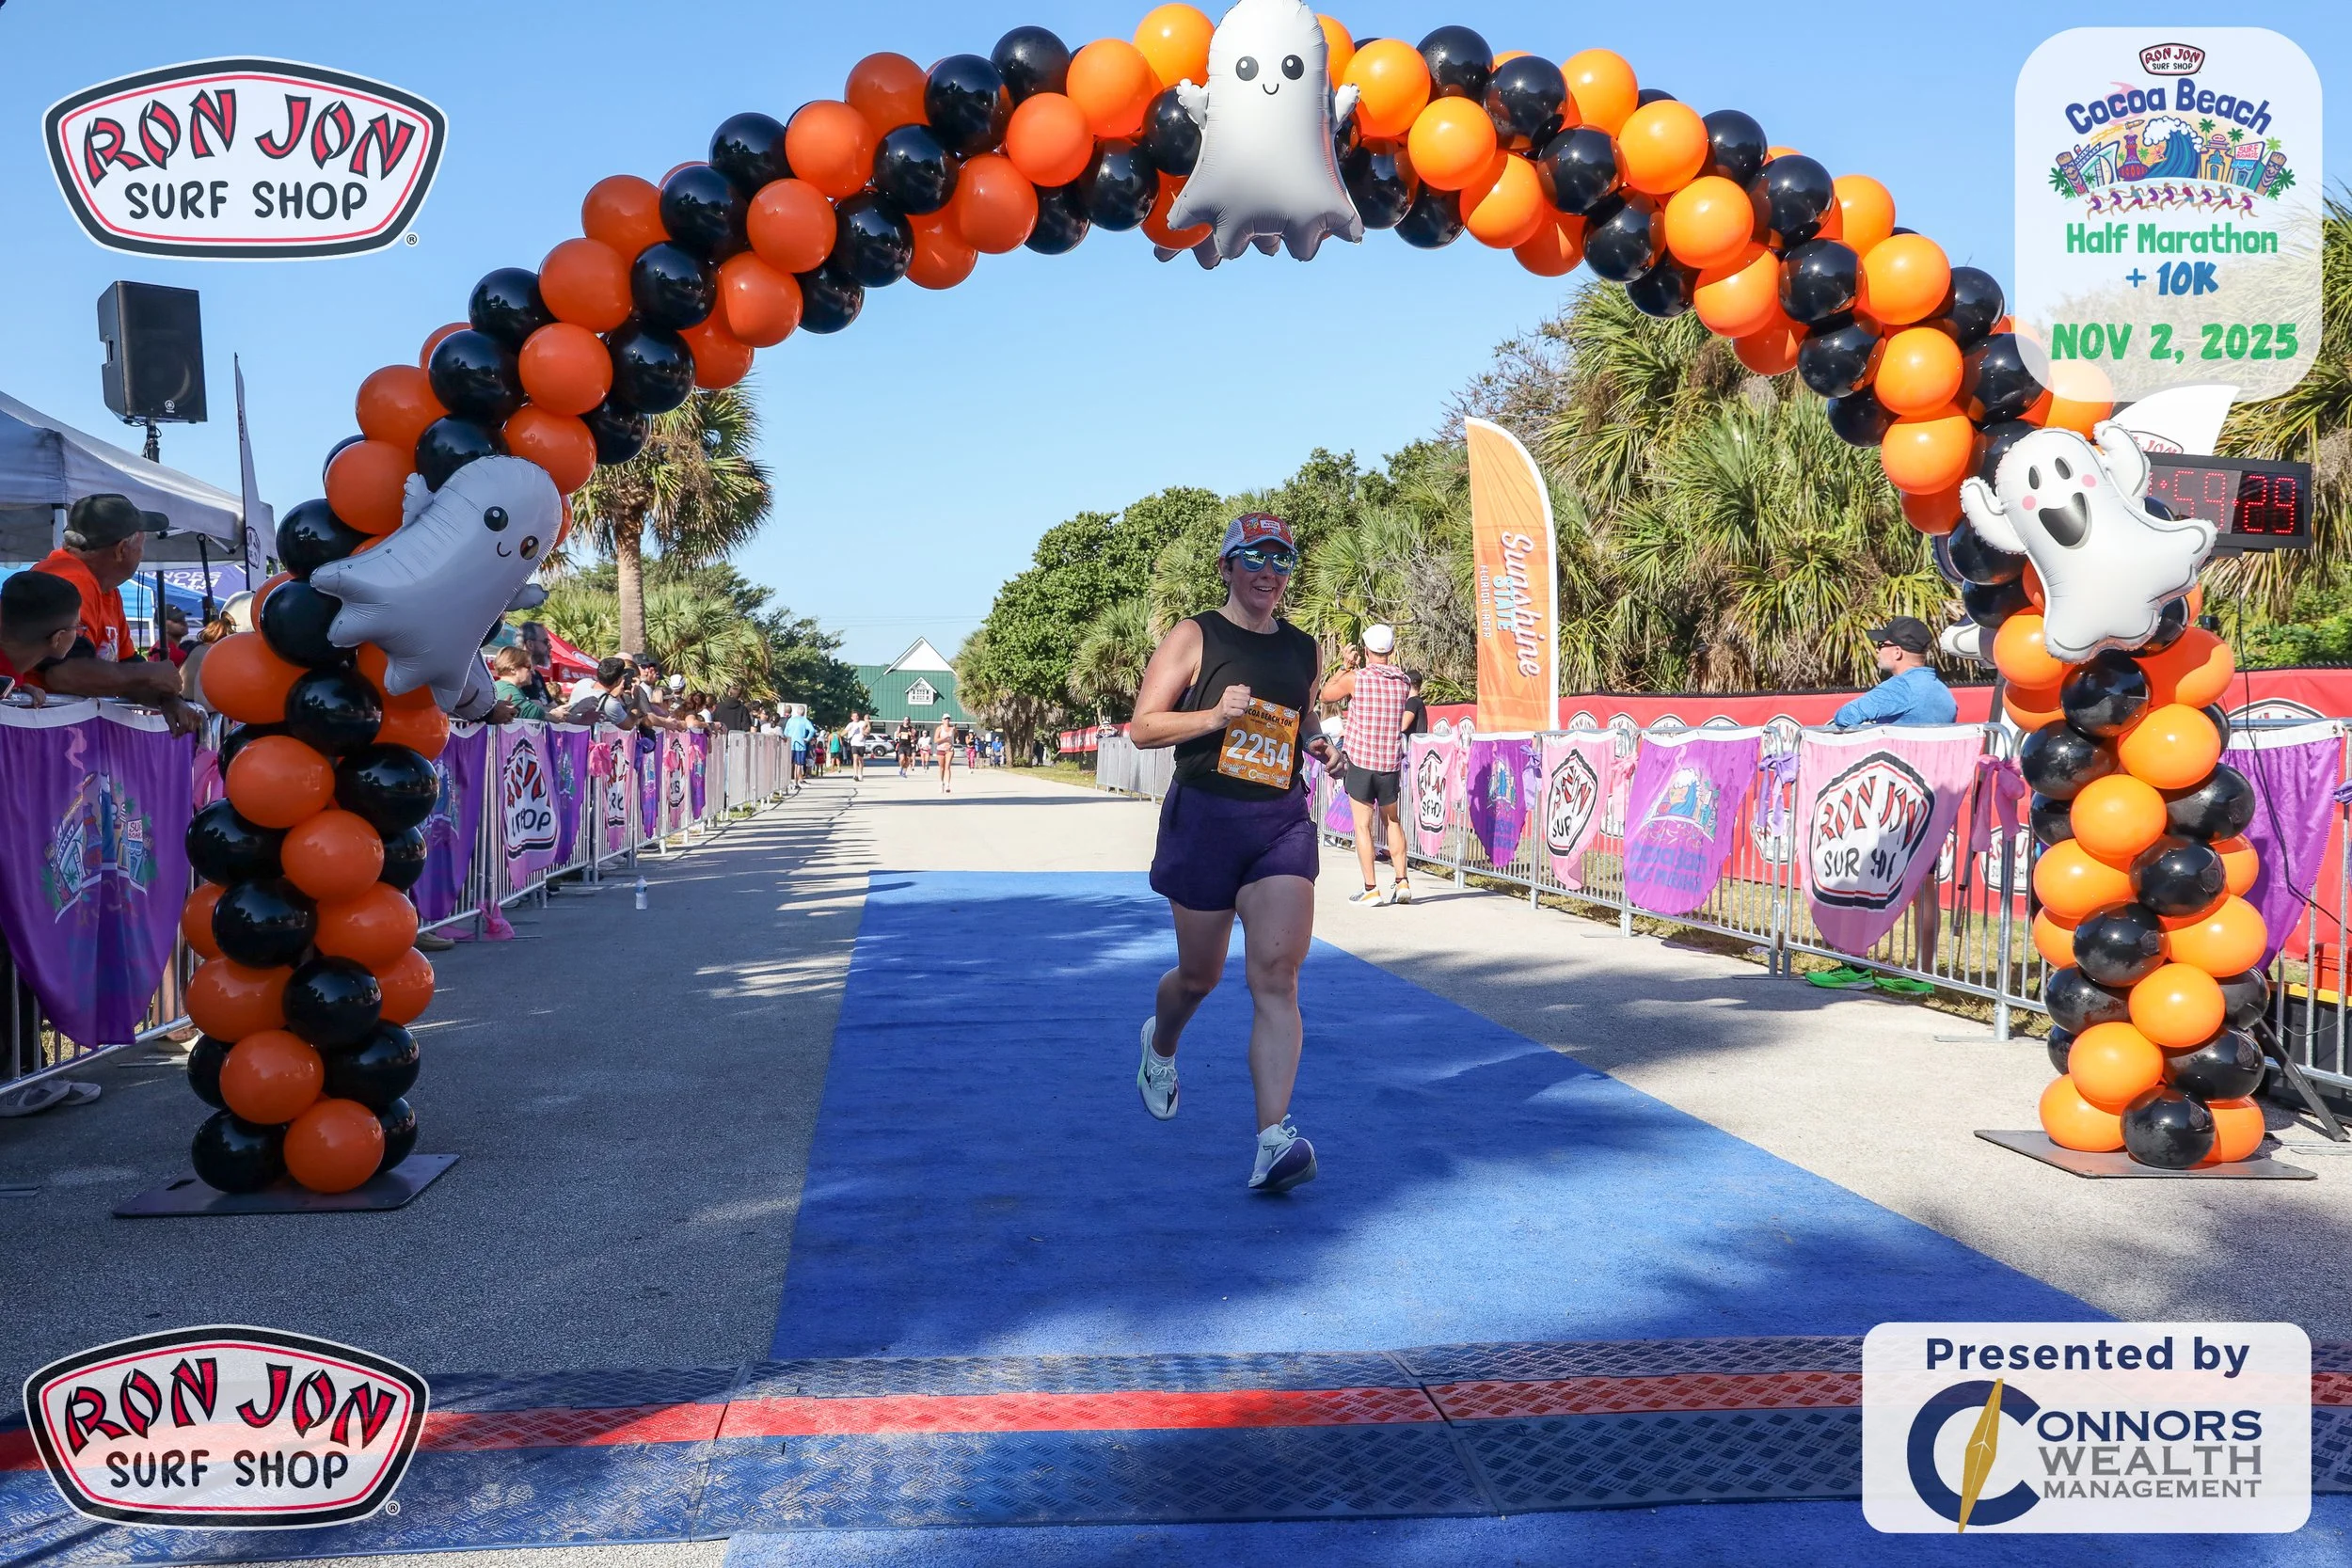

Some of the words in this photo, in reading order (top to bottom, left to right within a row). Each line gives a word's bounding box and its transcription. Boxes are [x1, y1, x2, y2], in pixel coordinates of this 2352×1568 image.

[1480, 564, 1490, 604] FLORIDA
[1492, 575, 1517, 633] STATE
[1501, 531, 1546, 678] Sunshine
[1481, 608, 1491, 639] LAGER
[1261, 712, 1280, 723] BEACH
[1281, 718, 1294, 727] 10K
[1226, 729, 1290, 771] 2254
[1817, 775, 1877, 850] RON
[1824, 847, 1860, 878] SUR
